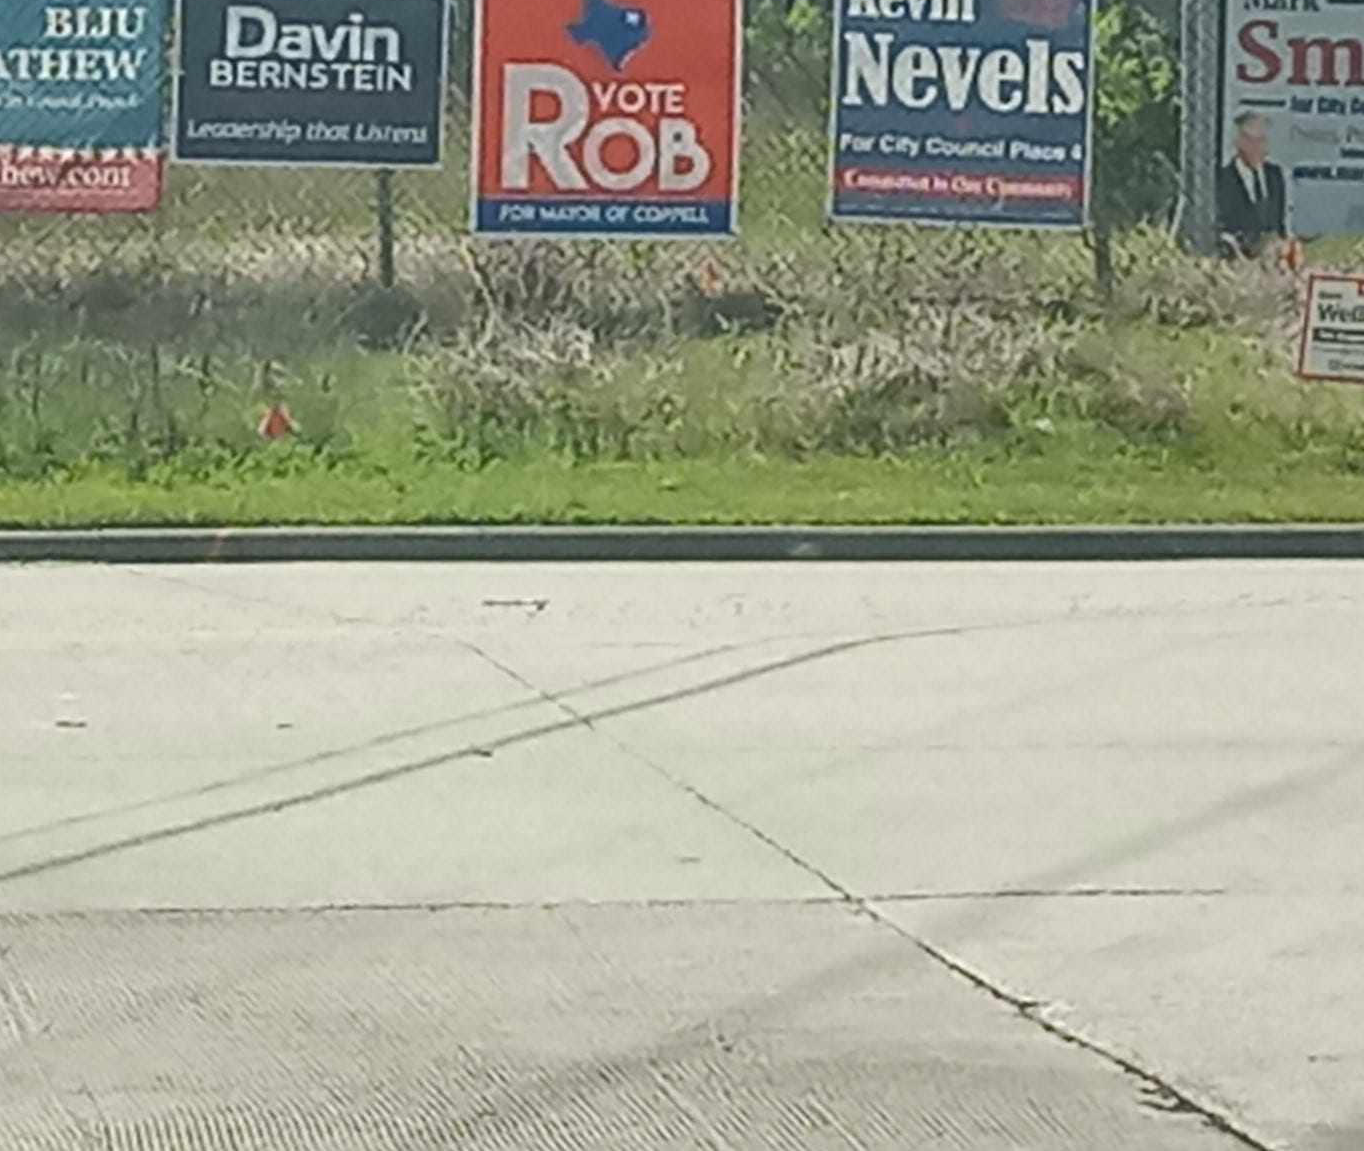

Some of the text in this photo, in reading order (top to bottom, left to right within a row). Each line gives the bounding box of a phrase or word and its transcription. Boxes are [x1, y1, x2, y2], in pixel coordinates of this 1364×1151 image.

[43, 5, 149, 41] BIJU
[224, 4, 401, 64] Davin
[208, 58, 413, 92] BERNSTEIN
[840, 30, 1086, 115] Nevels
[590, 81, 686, 115] VOTE
[1316, 96, 1346, 116] City
[186, 117, 429, 145] Leadership that Listens
[500, 61, 712, 192] ROB
[839, 132, 875, 153] For
[879, 134, 920, 157] City
[925, 136, 1005, 159] Council
[1009, 139, 1066, 162] Place
[498, 203, 710, 225] FOR MAYOR OF COPPELL
